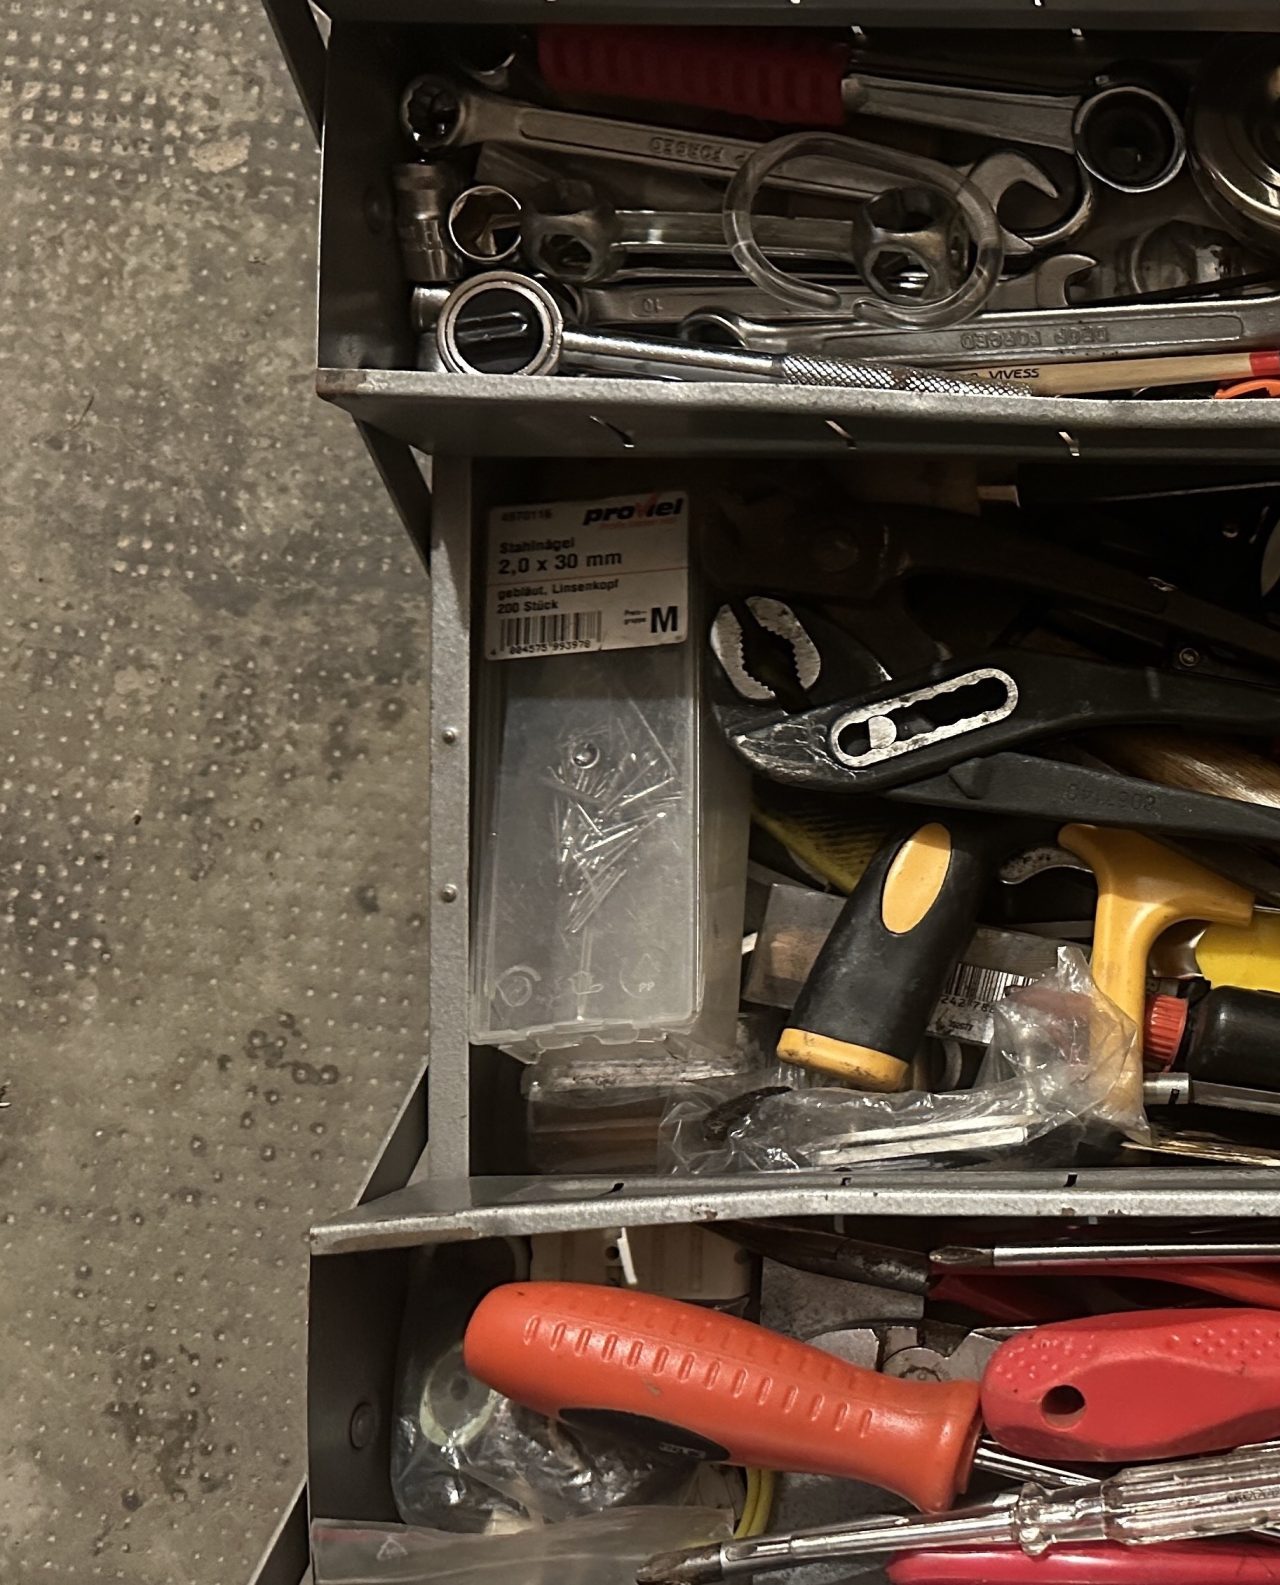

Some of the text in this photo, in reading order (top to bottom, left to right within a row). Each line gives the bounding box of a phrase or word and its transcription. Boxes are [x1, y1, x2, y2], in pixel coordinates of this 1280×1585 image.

[989, 368, 1040, 380] VIVESS
[498, 552, 622, 576] 2,0 x 30 mm
[552, 579, 620, 596] Linsenkopf
[497, 600, 558, 614] 200 Stück
[650, 606, 678, 633] M
